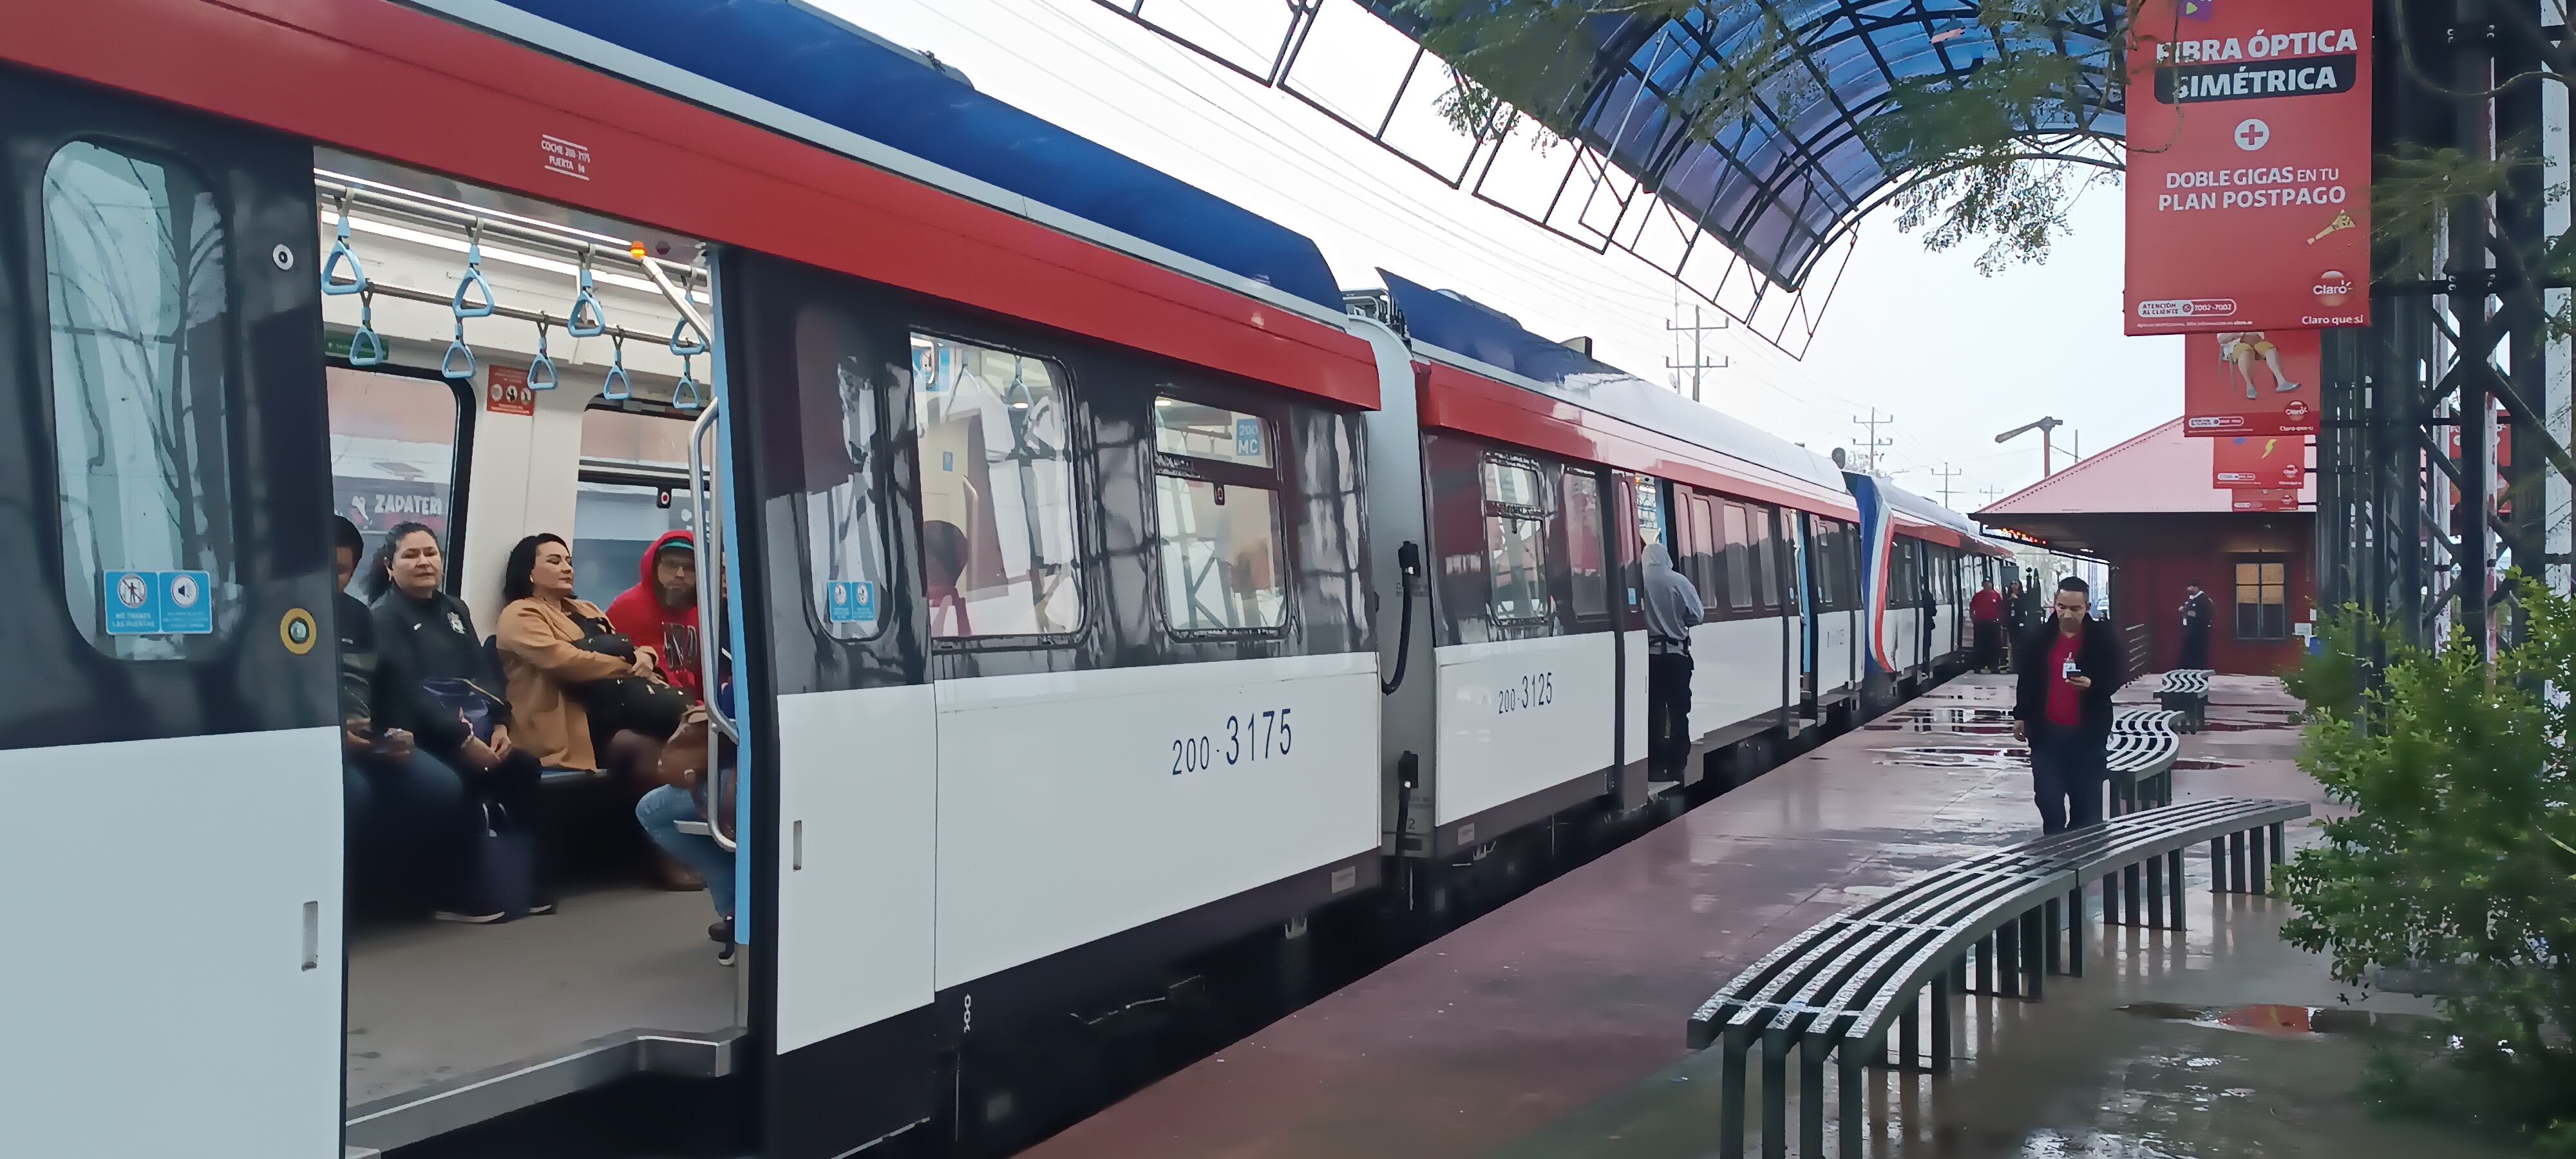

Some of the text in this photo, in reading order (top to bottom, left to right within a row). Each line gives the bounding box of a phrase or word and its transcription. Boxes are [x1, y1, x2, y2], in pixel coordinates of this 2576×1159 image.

[2156, 28, 2358, 63] FIBRA ÓPTICA
[2166, 166, 2339, 189] DOBLE GIGAS EN TU
[2159, 185, 2346, 211] PLAN POSTPAGO
[2313, 284, 2347, 295] Claro
[2302, 316, 2330, 325] Claro
[2331, 316, 2353, 326] que
[1238, 424, 1259, 437] 200
[1238, 438, 1258, 455] MC
